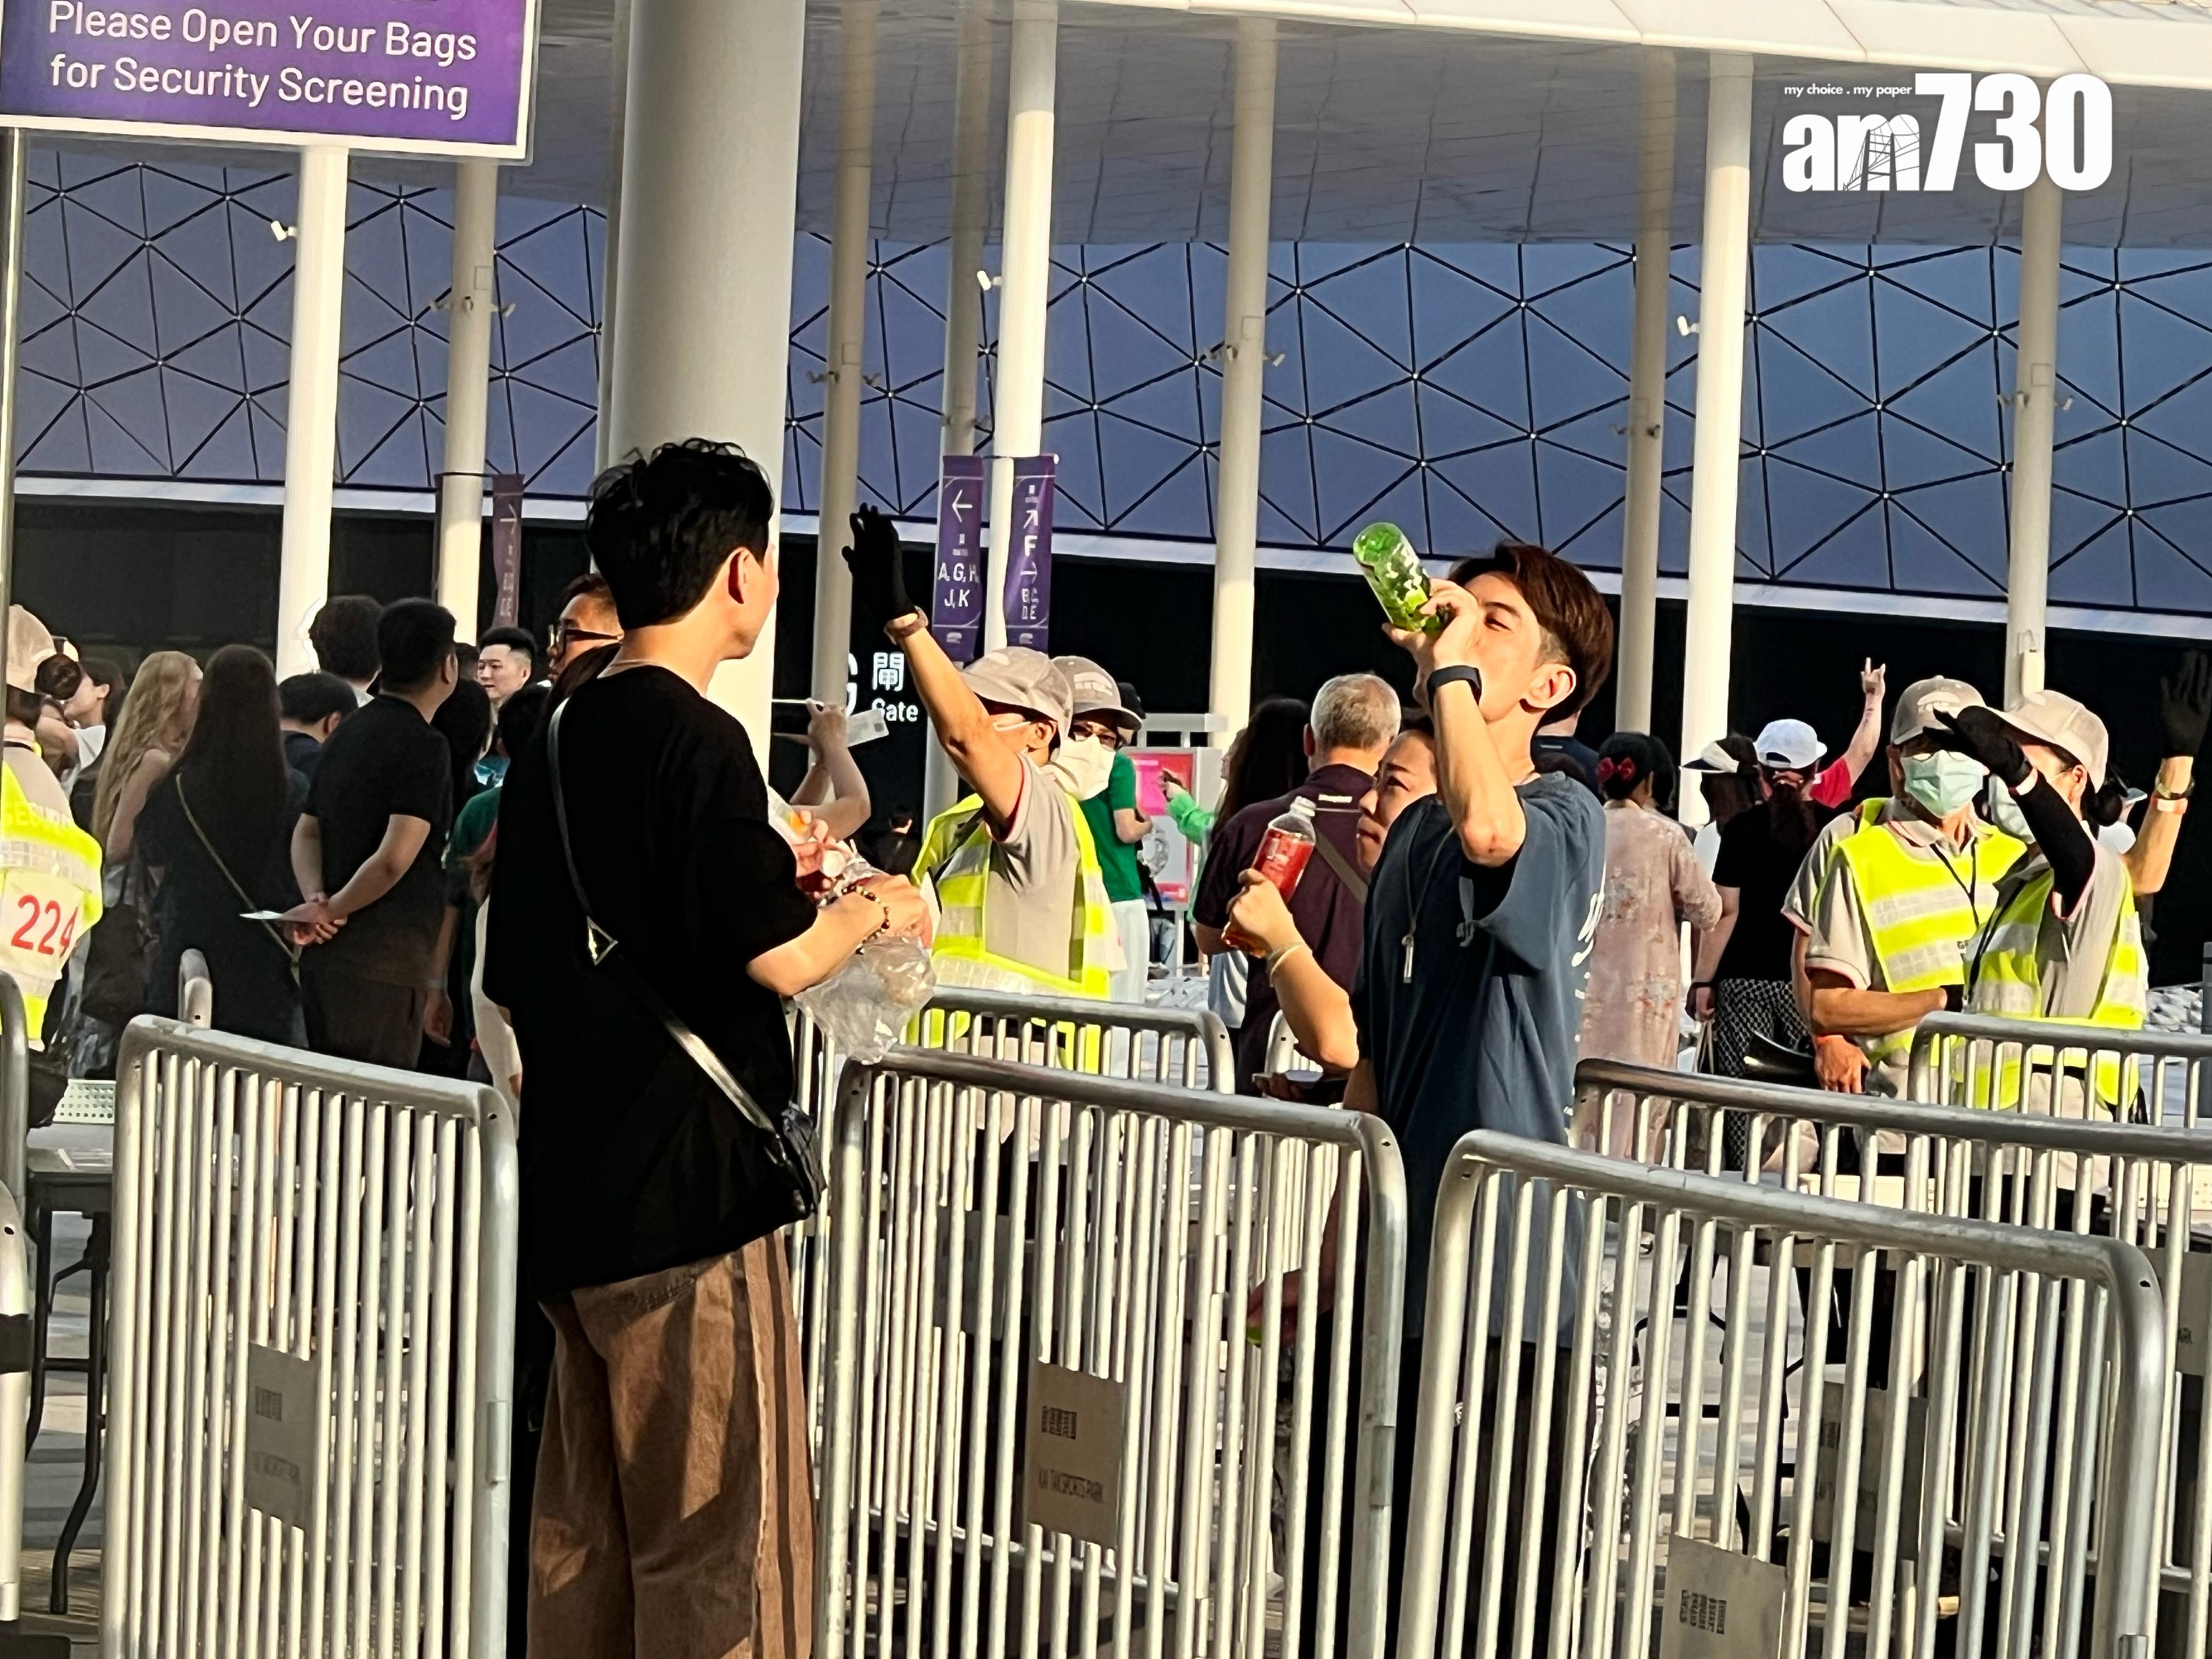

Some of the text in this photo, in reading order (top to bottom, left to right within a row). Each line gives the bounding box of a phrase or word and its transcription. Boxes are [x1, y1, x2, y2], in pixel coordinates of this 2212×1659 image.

[49, 1, 477, 67] Please Open Your Bags
[50, 53, 468, 120] for Security Screening
[1024, 535, 1038, 557] F
[11, 894, 78, 958] 224
